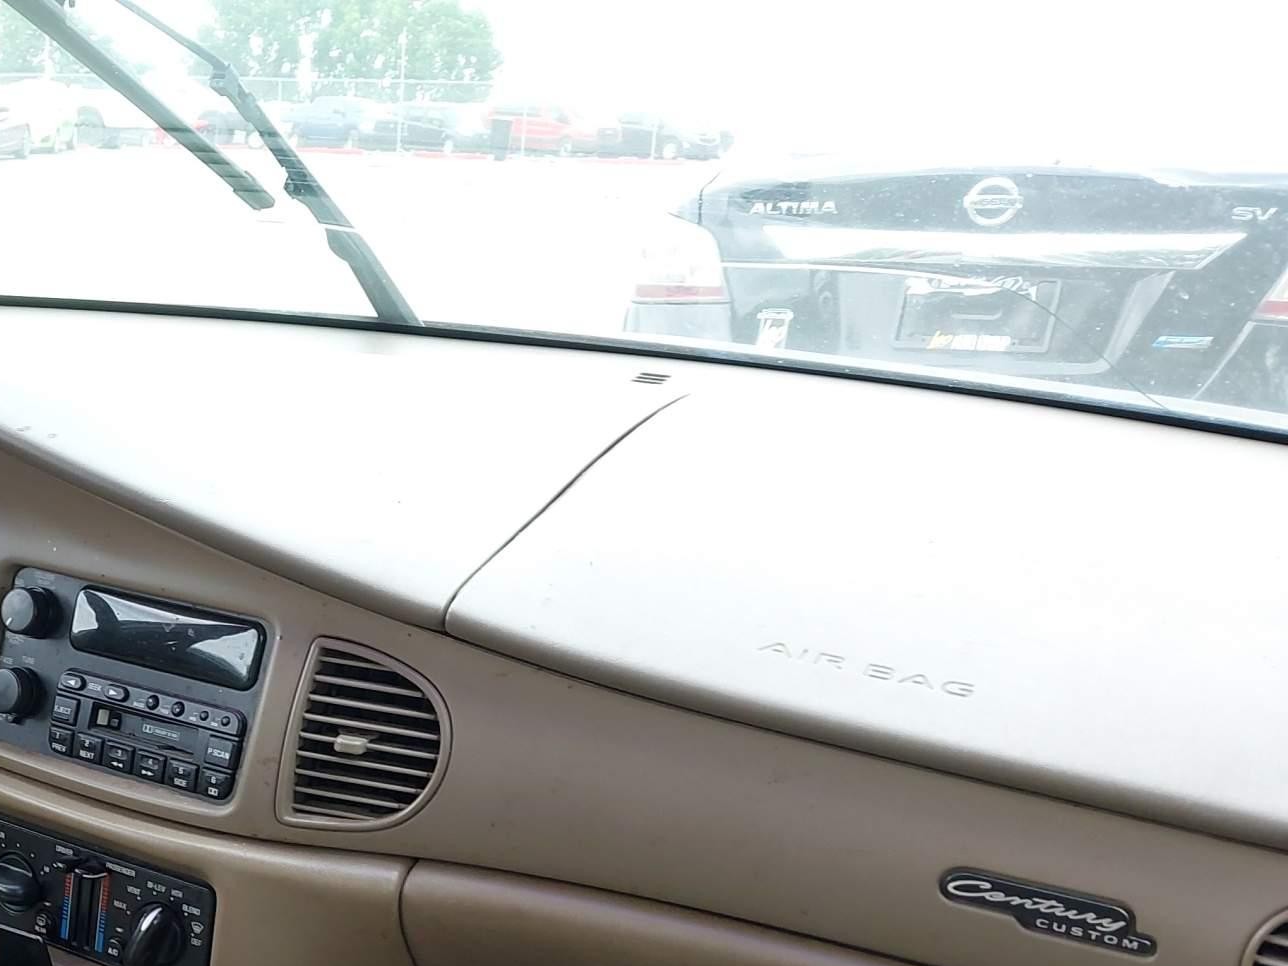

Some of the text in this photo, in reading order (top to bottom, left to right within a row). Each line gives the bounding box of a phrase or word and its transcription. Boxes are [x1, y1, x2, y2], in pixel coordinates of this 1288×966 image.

[749, 201, 839, 215] ALTIMA
[1231, 206, 1279, 221] SV
[757, 642, 975, 698] AIR BAG
[79, 749, 95, 760] NEXT
[113, 899, 128, 910] MAX
[946, 879, 1128, 932] Century
[1035, 918, 1140, 950] CUSTOM
